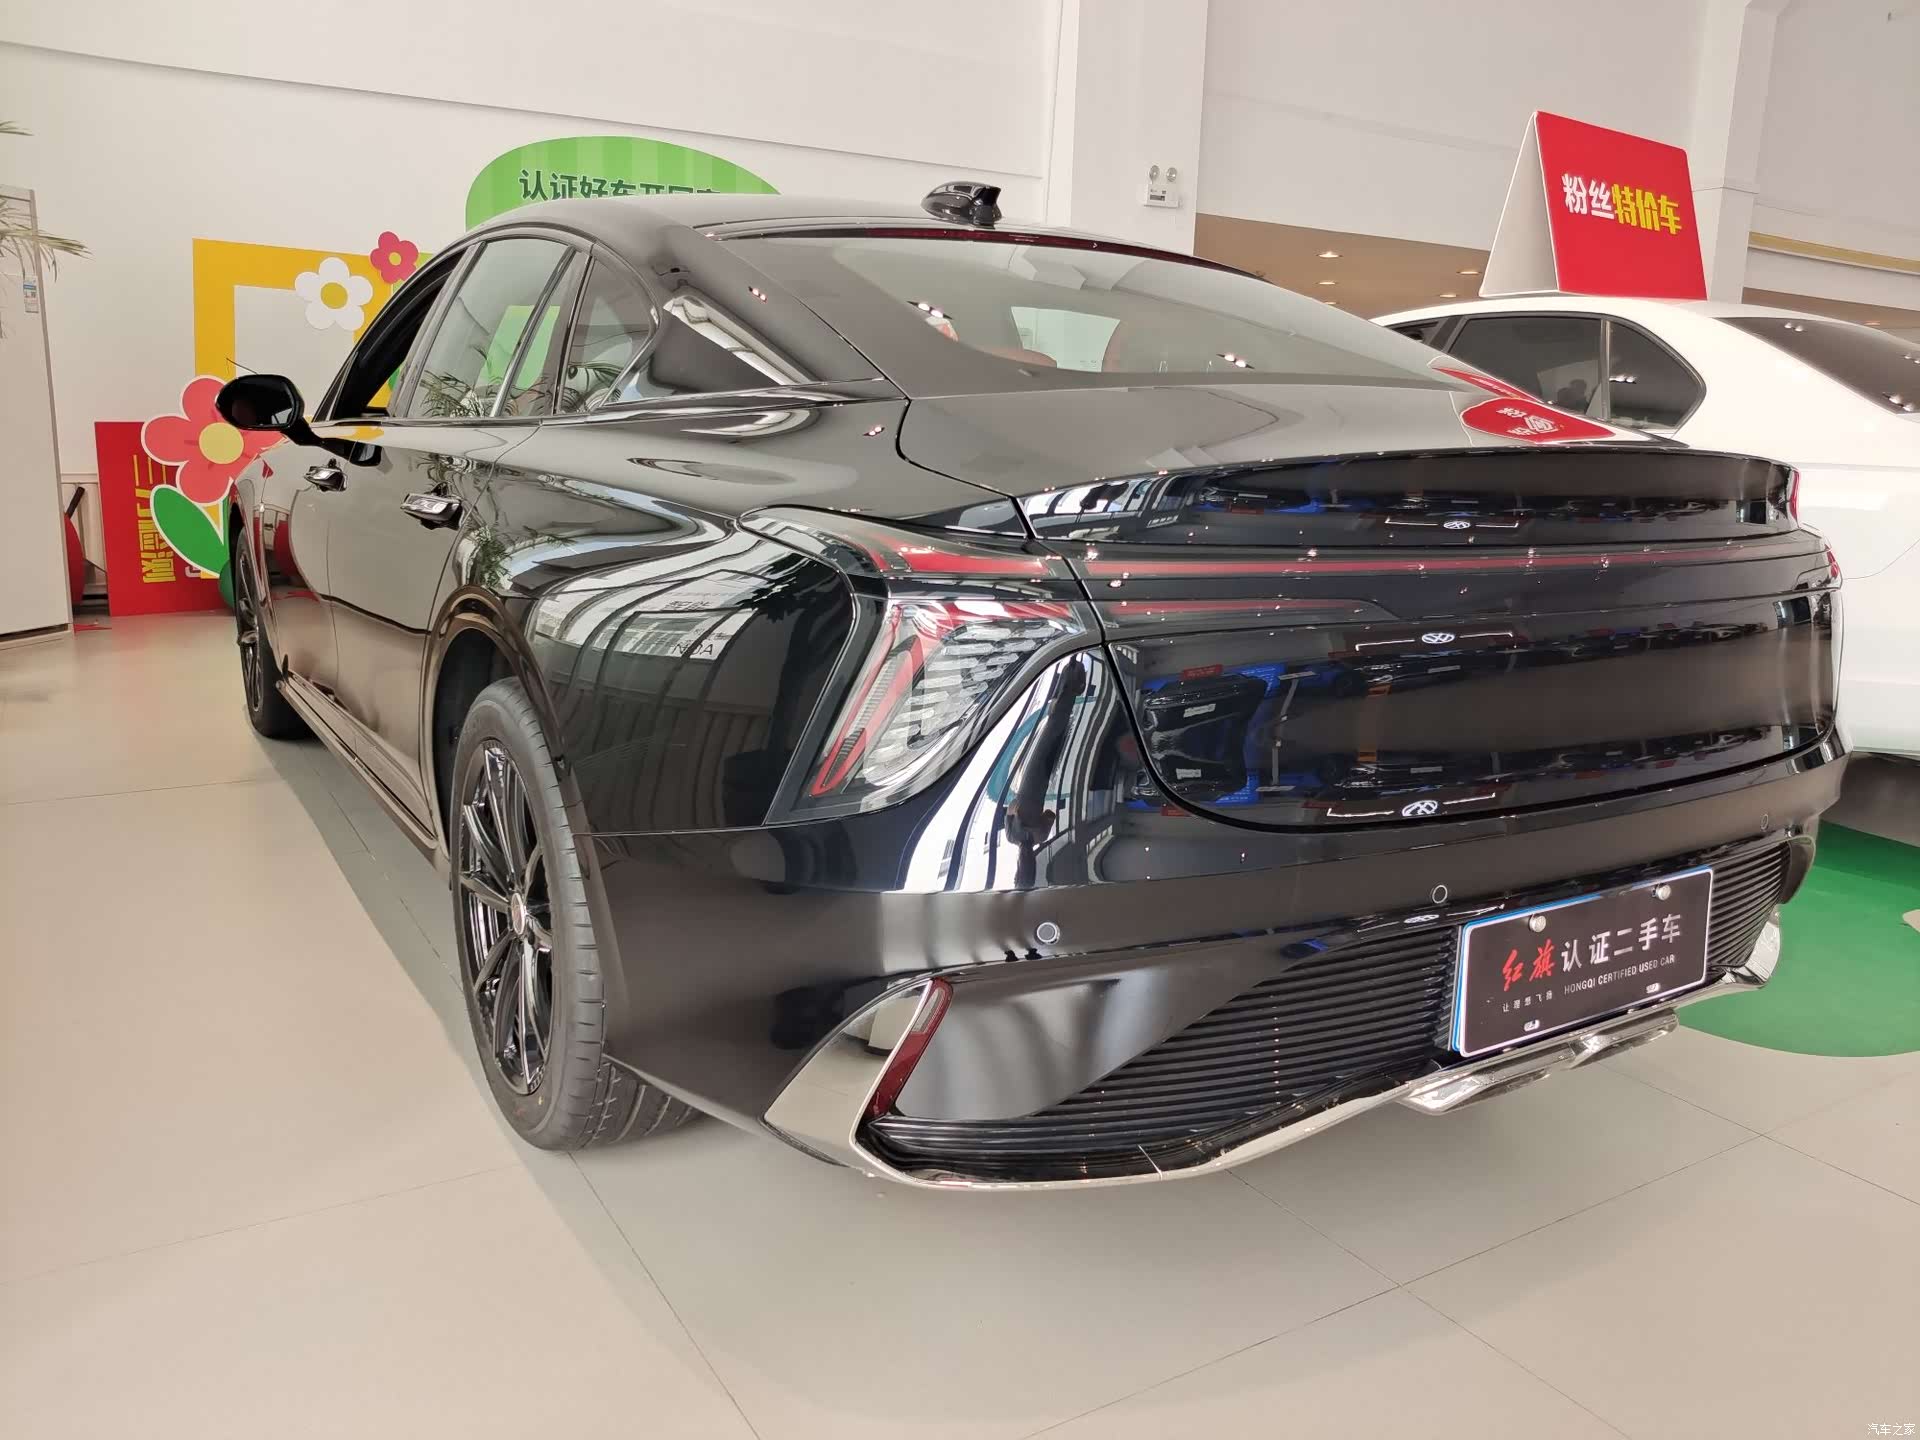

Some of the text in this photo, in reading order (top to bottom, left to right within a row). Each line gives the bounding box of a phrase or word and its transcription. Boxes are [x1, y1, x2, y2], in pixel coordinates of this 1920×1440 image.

[519, 169, 720, 201] 认证好车
[1561, 173, 1682, 235] 粉丝特价车
[1564, 954, 1675, 995] HONGQI CERTIFIED USED CAR
